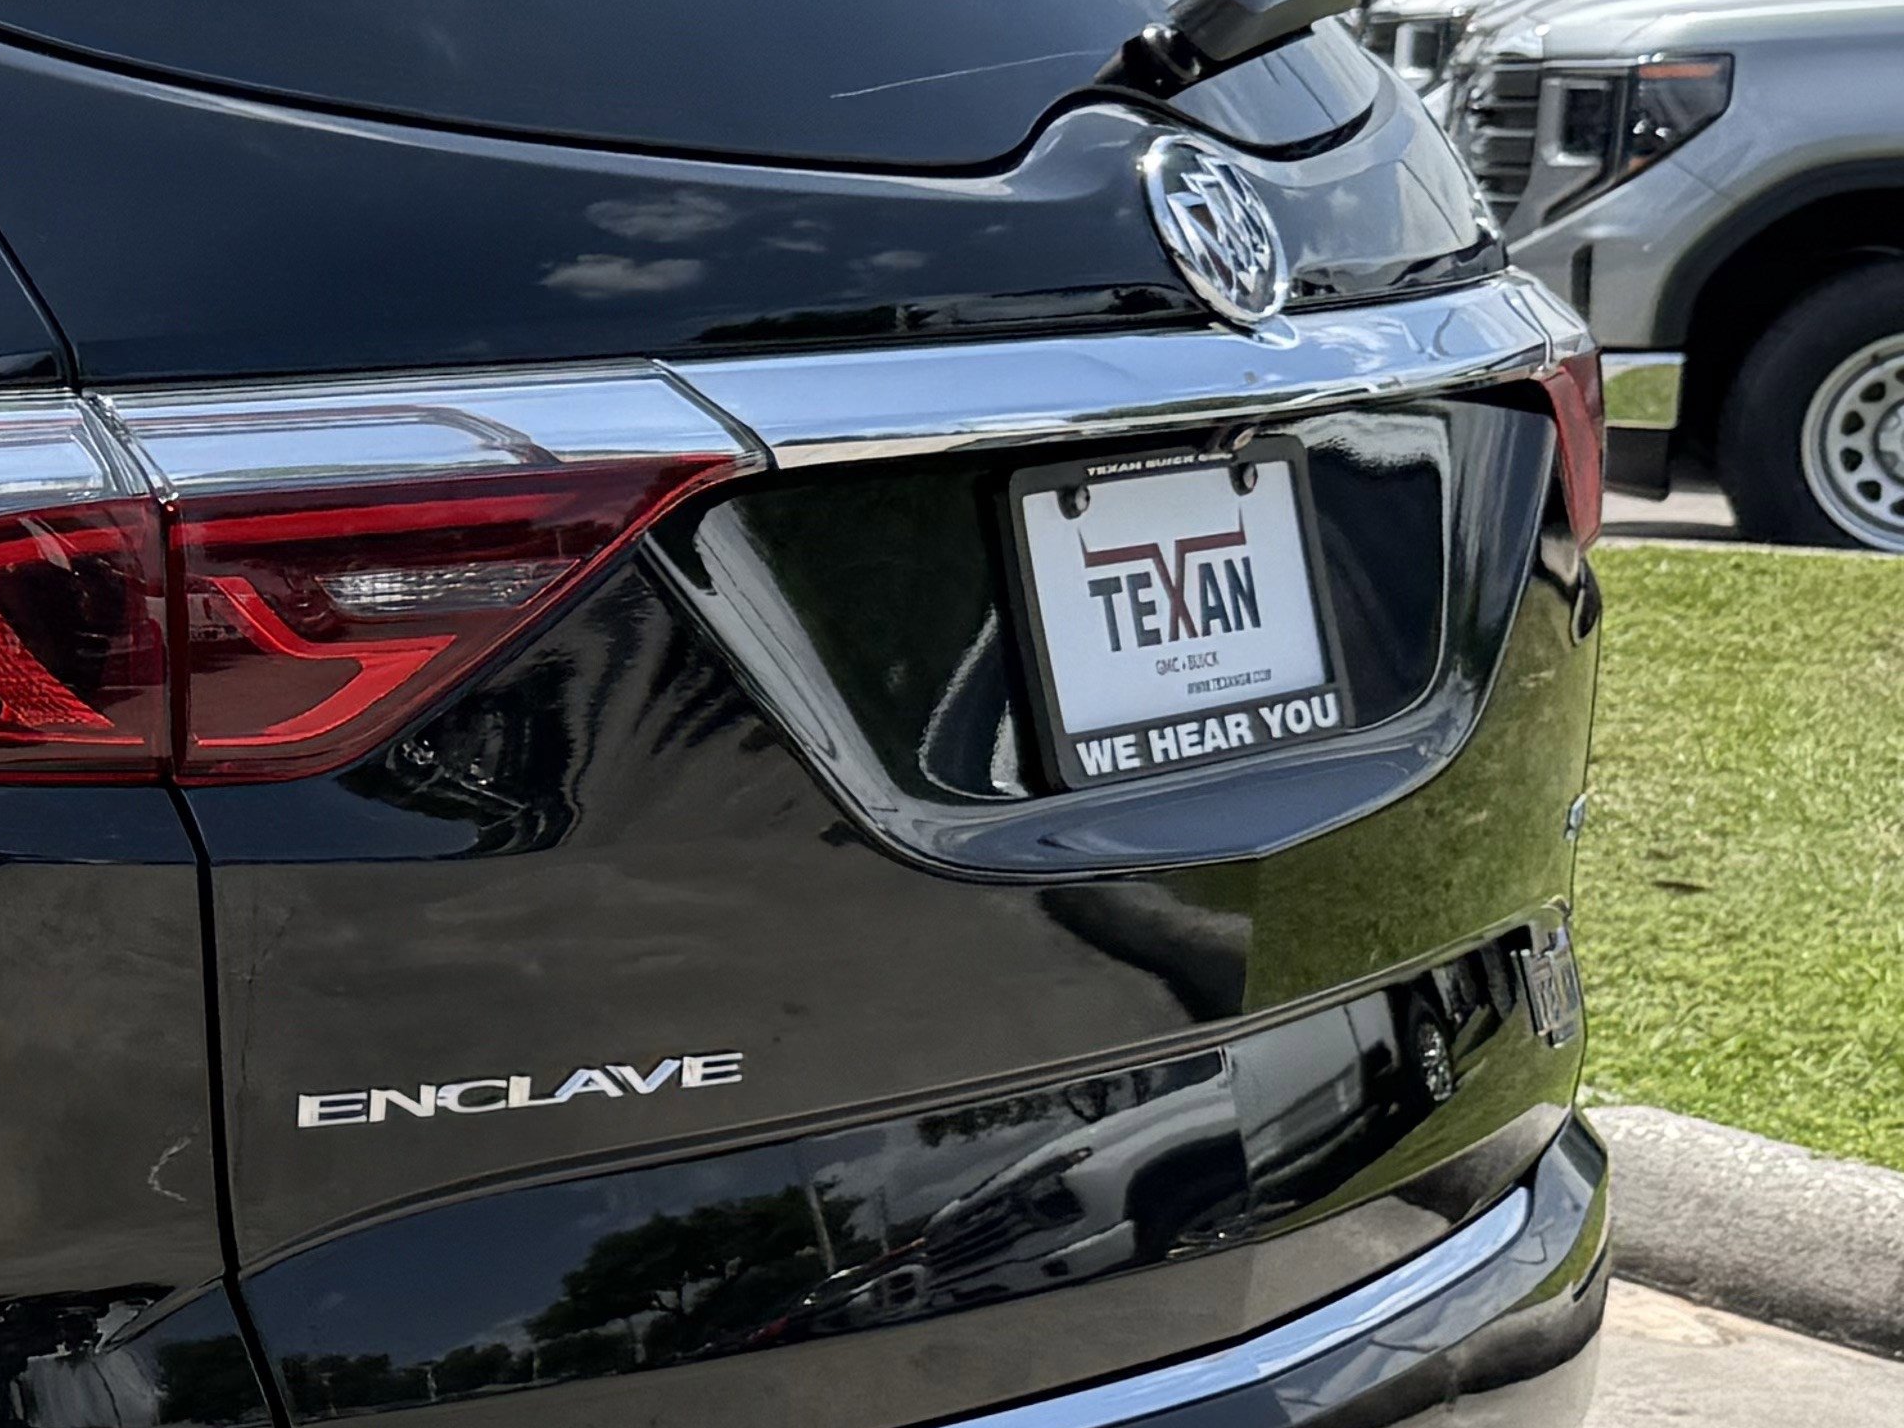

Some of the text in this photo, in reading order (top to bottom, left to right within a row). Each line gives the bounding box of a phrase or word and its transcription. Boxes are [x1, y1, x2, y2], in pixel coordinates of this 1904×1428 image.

[1086, 460, 1142, 477] TEXAN
[1085, 528, 1262, 653] TEXAN
[1076, 692, 1339, 776] WE HEAR YOU
[297, 1052, 744, 1128] ENCLAVE
